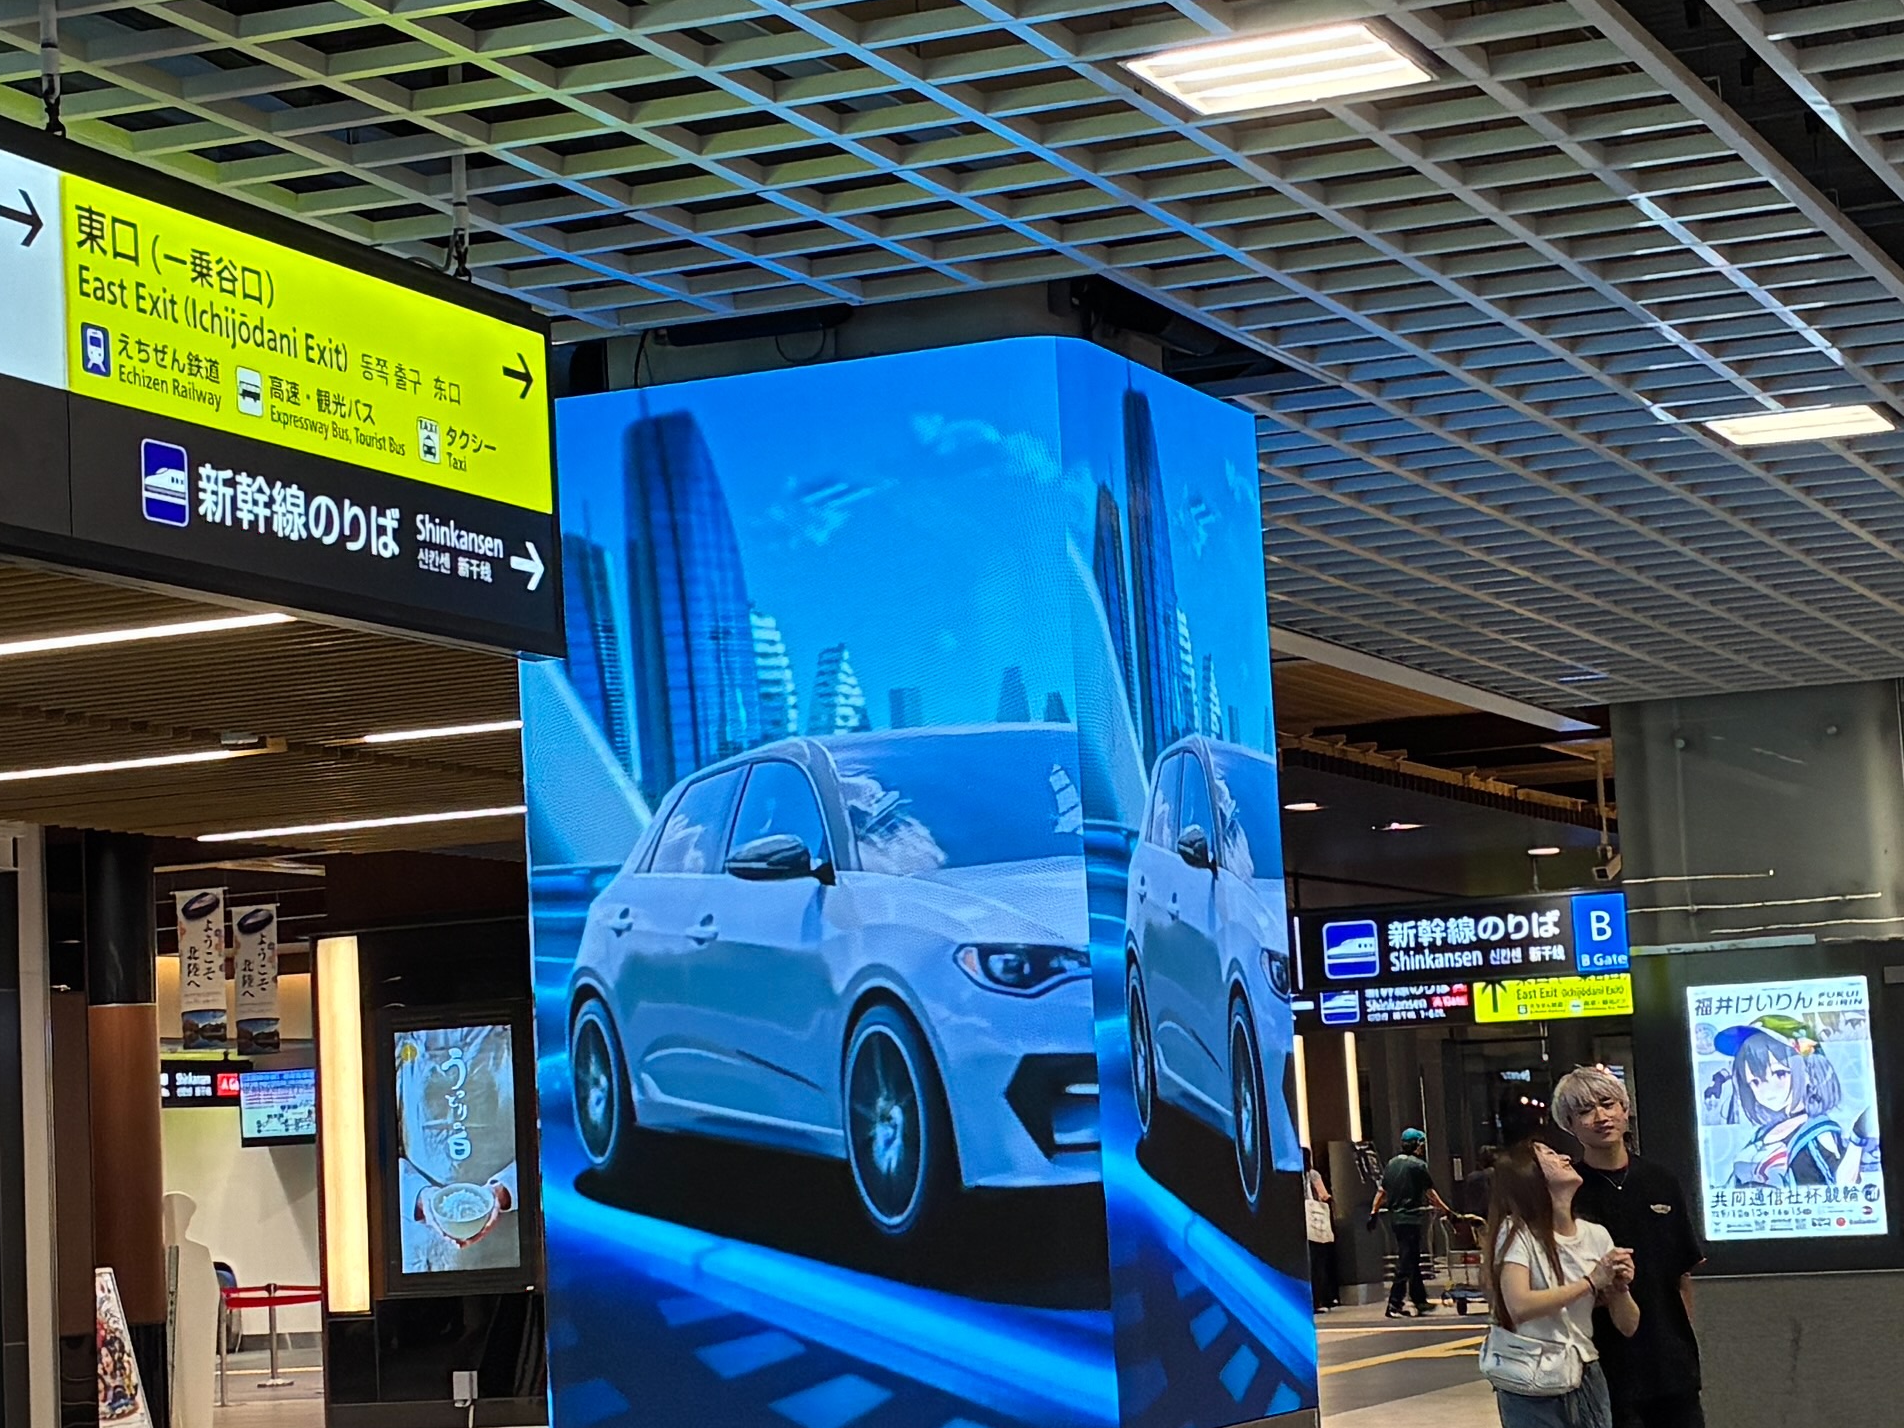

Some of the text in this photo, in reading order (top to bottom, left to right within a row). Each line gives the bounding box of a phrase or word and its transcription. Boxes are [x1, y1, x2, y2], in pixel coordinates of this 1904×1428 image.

[78, 264, 348, 373] East Exit (Ichijōdani Exit)
[118, 332, 221, 385] えちぜん鉄道
[118, 364, 222, 413] Echizen Railway
[395, 363, 422, 396] 출구
[433, 376, 461, 405] 东口
[269, 375, 376, 425] 高速・観光バス
[270, 405, 330, 441] Expressway
[353, 426, 387, 452] Tourist
[389, 434, 406, 457] Bus
[446, 425, 497, 453] タクシー
[446, 451, 468, 472] Taxi
[197, 462, 400, 559] 新幹線のりば
[415, 513, 504, 559] Shinkansen
[1388, 909, 1560, 949] 新幹線のりば
[1590, 910, 1612, 941] B
[1390, 948, 1483, 973] Shinkansen
[1581, 952, 1628, 967] B Gate
[1695, 992, 1813, 1016] 福井けいりん
